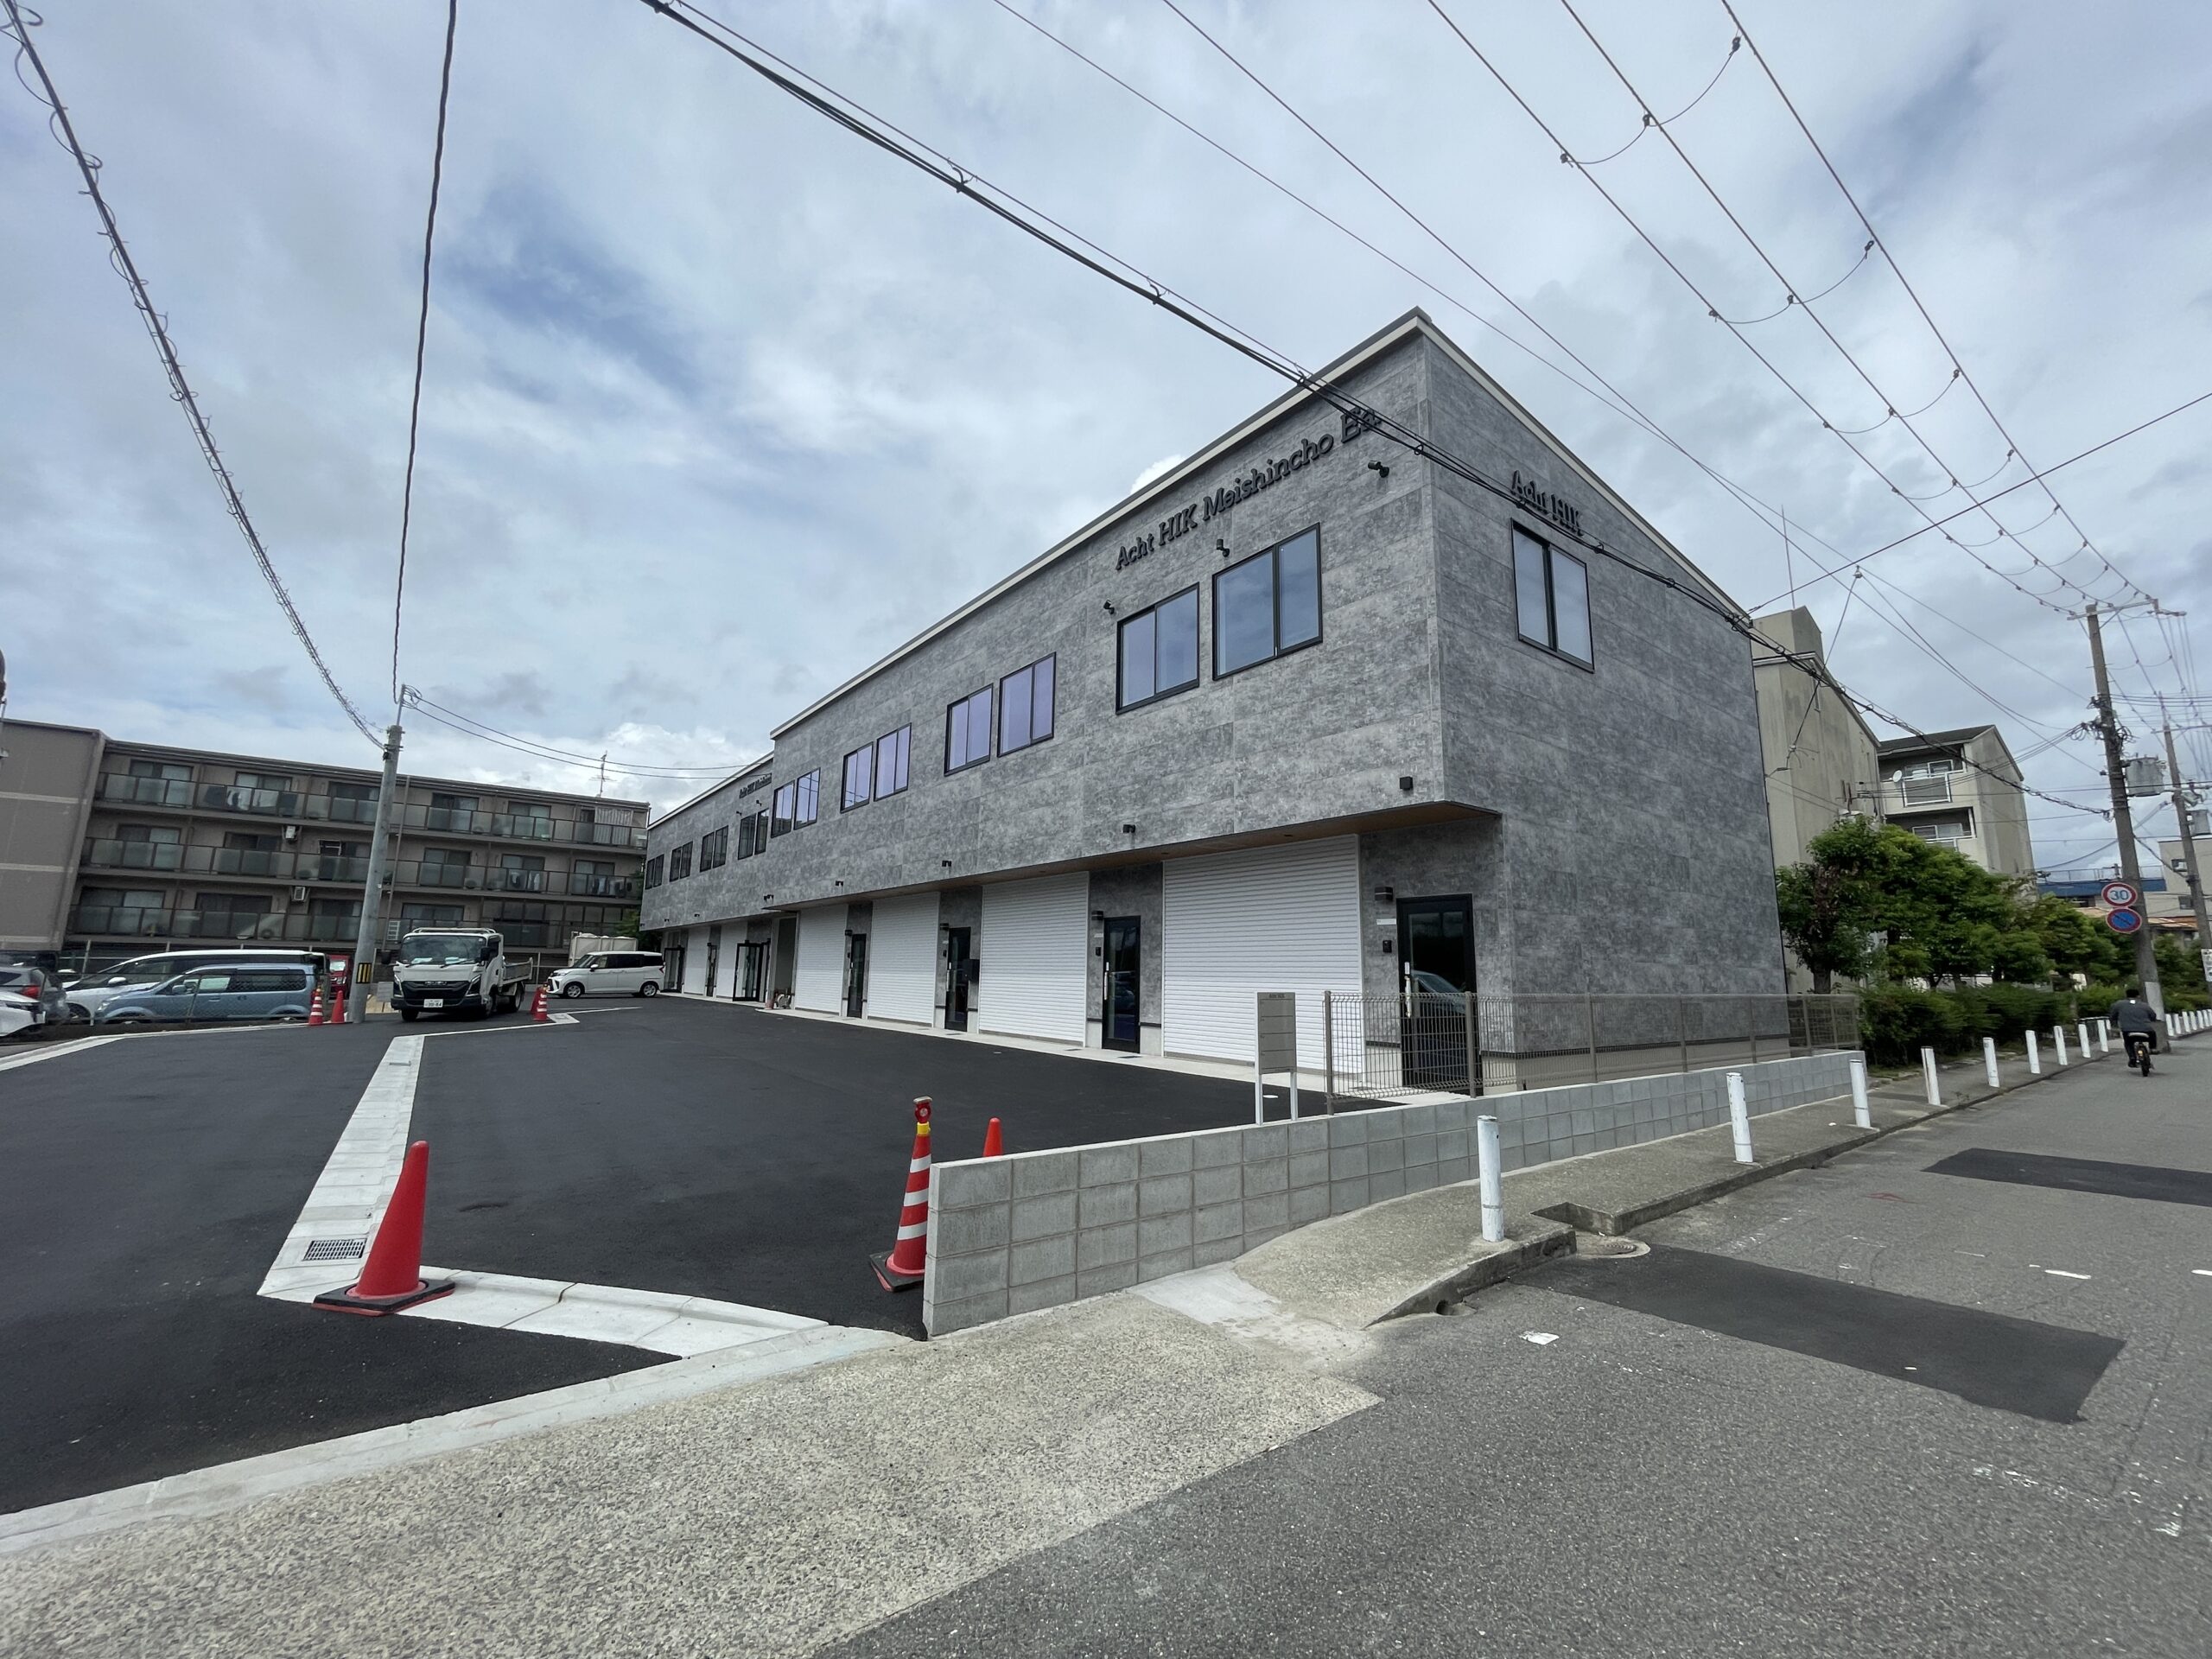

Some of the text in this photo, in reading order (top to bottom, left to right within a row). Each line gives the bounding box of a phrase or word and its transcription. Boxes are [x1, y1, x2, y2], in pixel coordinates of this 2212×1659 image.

[1115, 532, 1154, 571] Acht
[1158, 504, 1198, 547] HIK
[1202, 433, 1335, 522] Meishincho
[2110, 890, 2129, 900] 30
